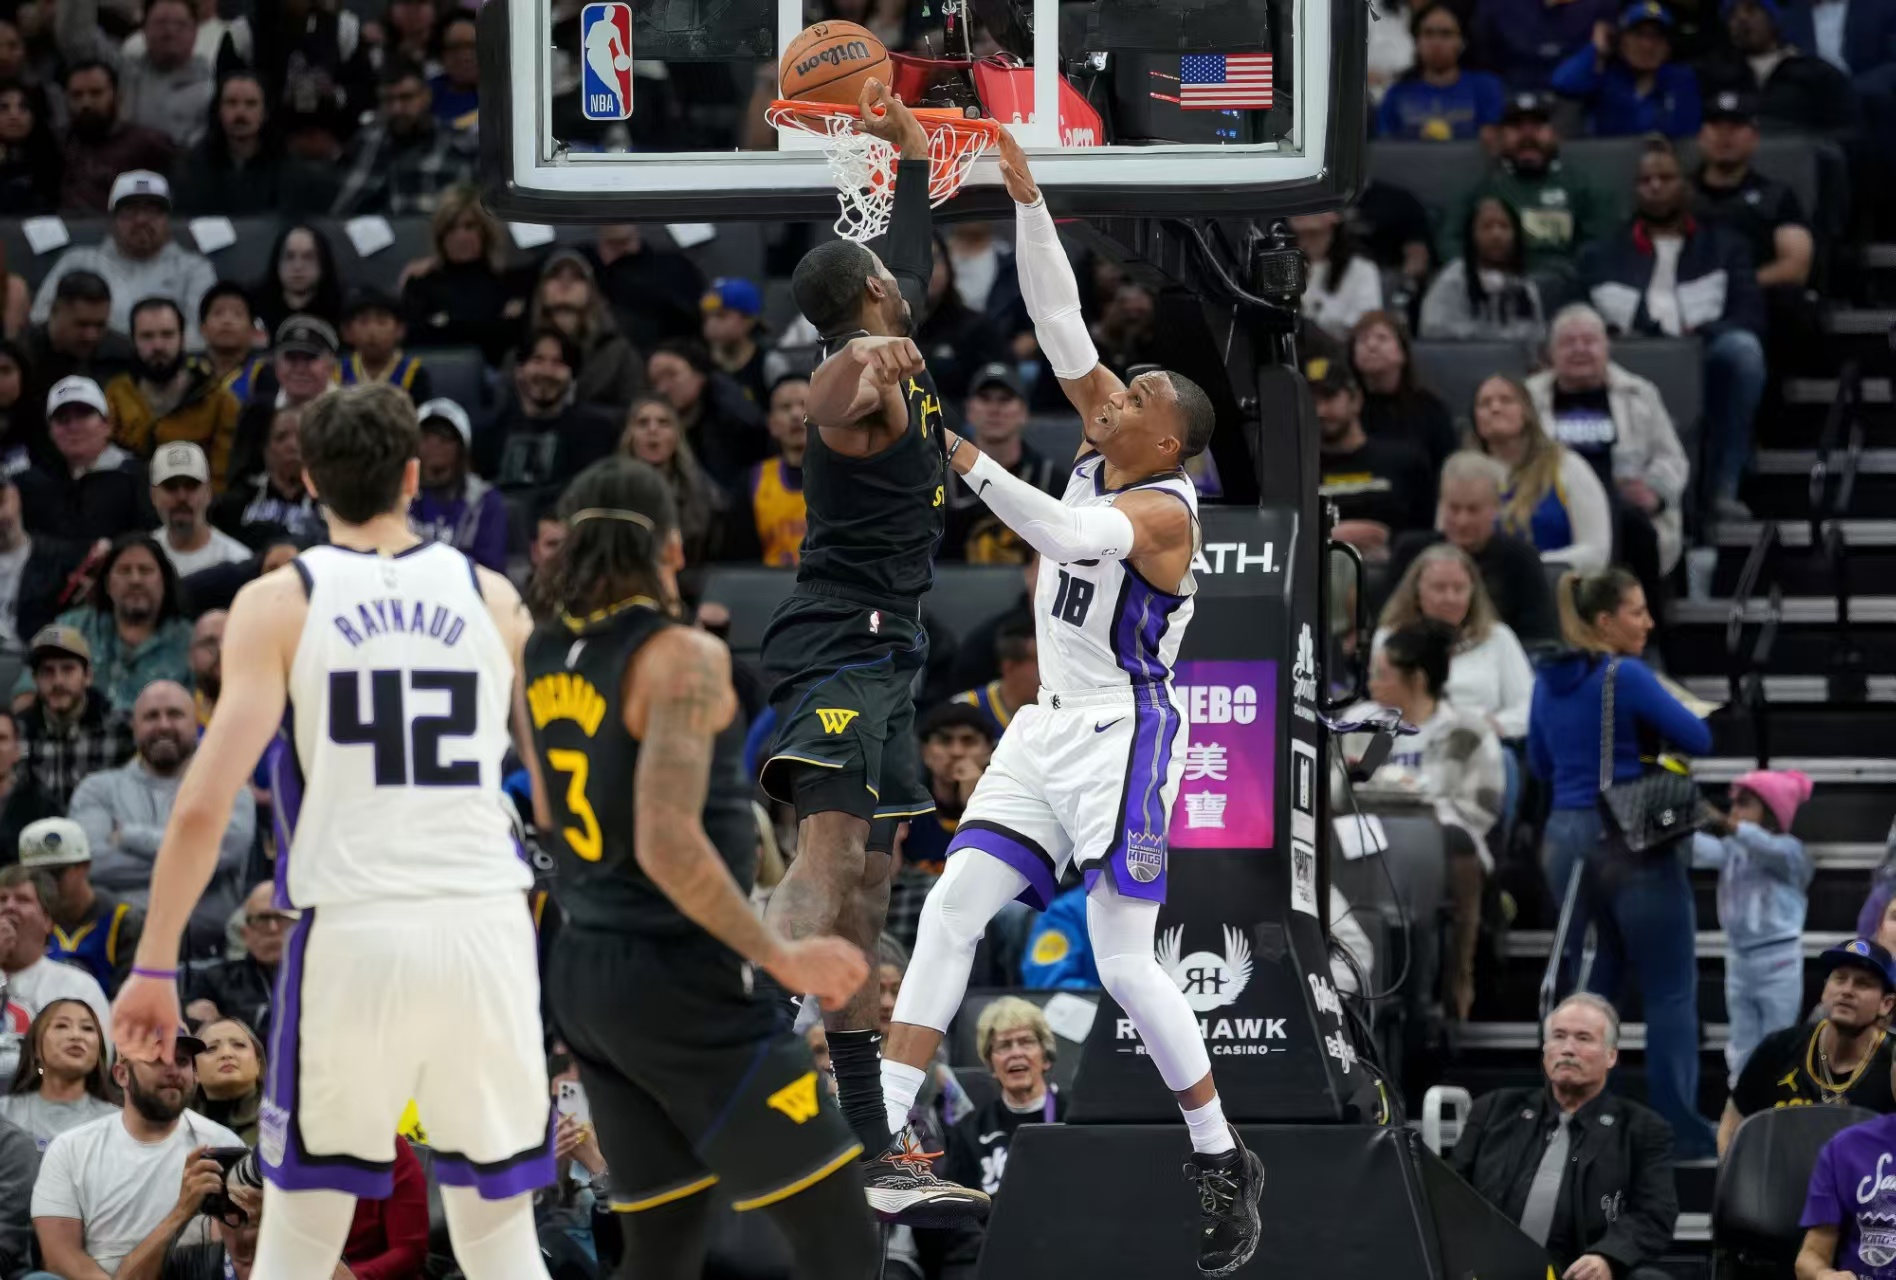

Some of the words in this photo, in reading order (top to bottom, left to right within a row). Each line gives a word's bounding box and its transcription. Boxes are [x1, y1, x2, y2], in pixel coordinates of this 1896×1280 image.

[795, 41, 871, 77] Wilson
[590, 94, 614, 113] NBA
[1050, 568, 1095, 628] 18
[333, 599, 466, 648] RAYNAUD
[328, 668, 482, 788] 42
[815, 708, 860, 734] W
[548, 748, 603, 862] 3
[1128, 850, 1161, 866] KINGS
[1212, 1045, 1268, 1055] CASINO
